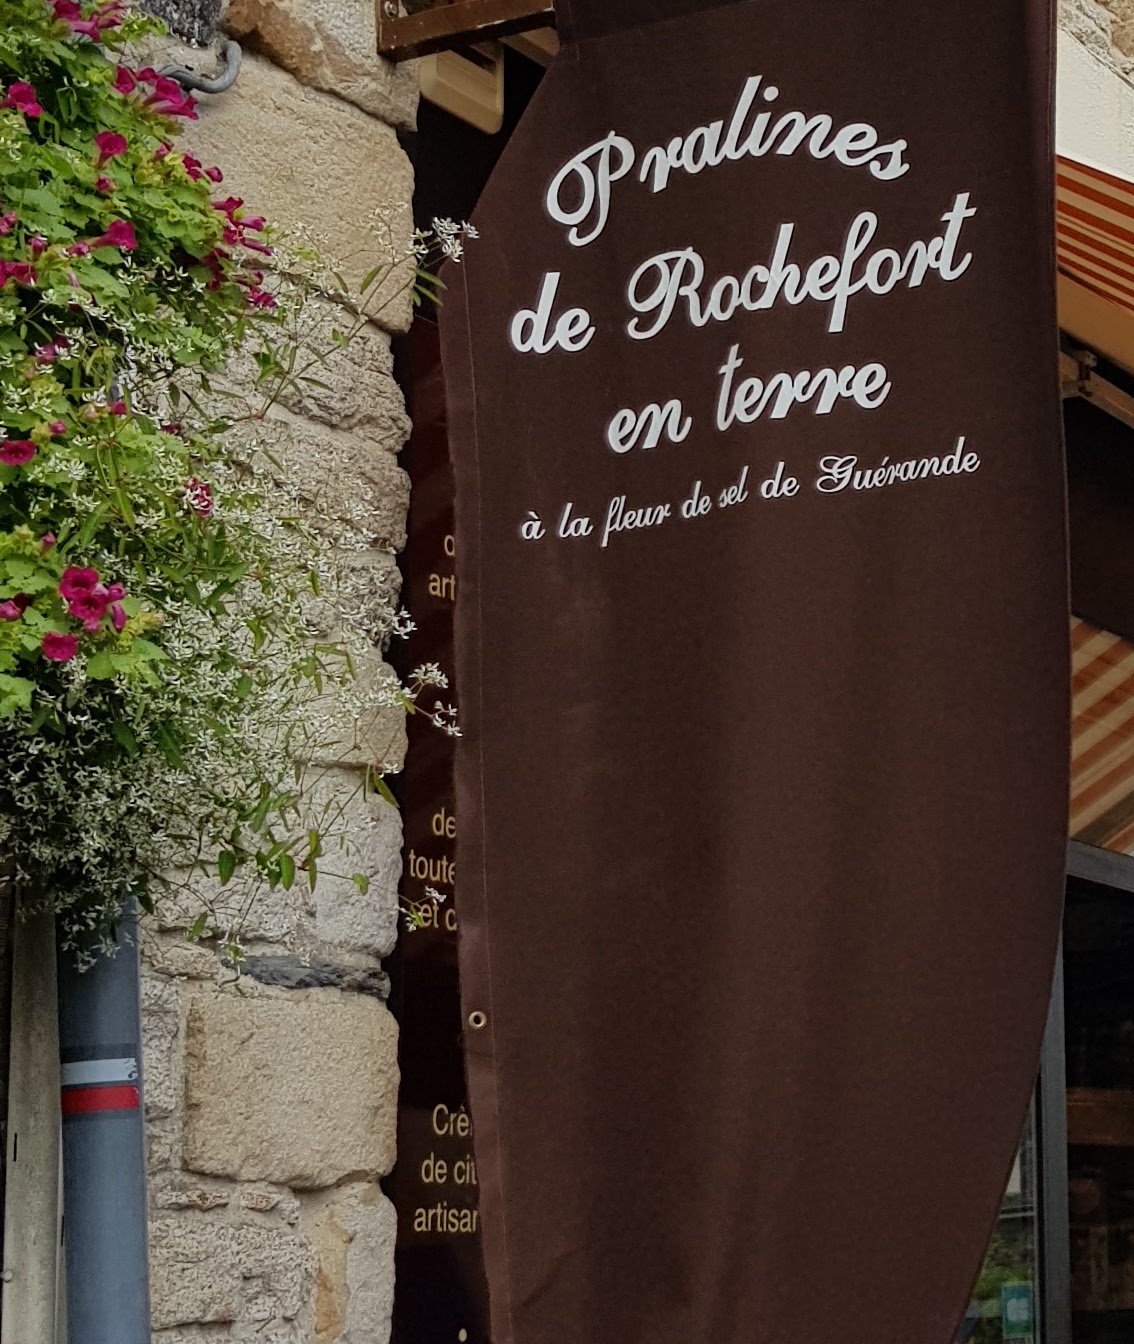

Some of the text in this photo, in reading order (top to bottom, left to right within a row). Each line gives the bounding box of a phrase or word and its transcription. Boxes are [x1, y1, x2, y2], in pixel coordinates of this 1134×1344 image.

[545, 74, 911, 247] Pralines
[510, 191, 978, 355] de Rochefort
[607, 343, 892, 454] en terre
[521, 436, 981, 548] à la fleur de sel de Guérande
[409, 849, 456, 884] toute
[421, 1152, 448, 1183] de
[433, 1103, 473, 1136] Crè
